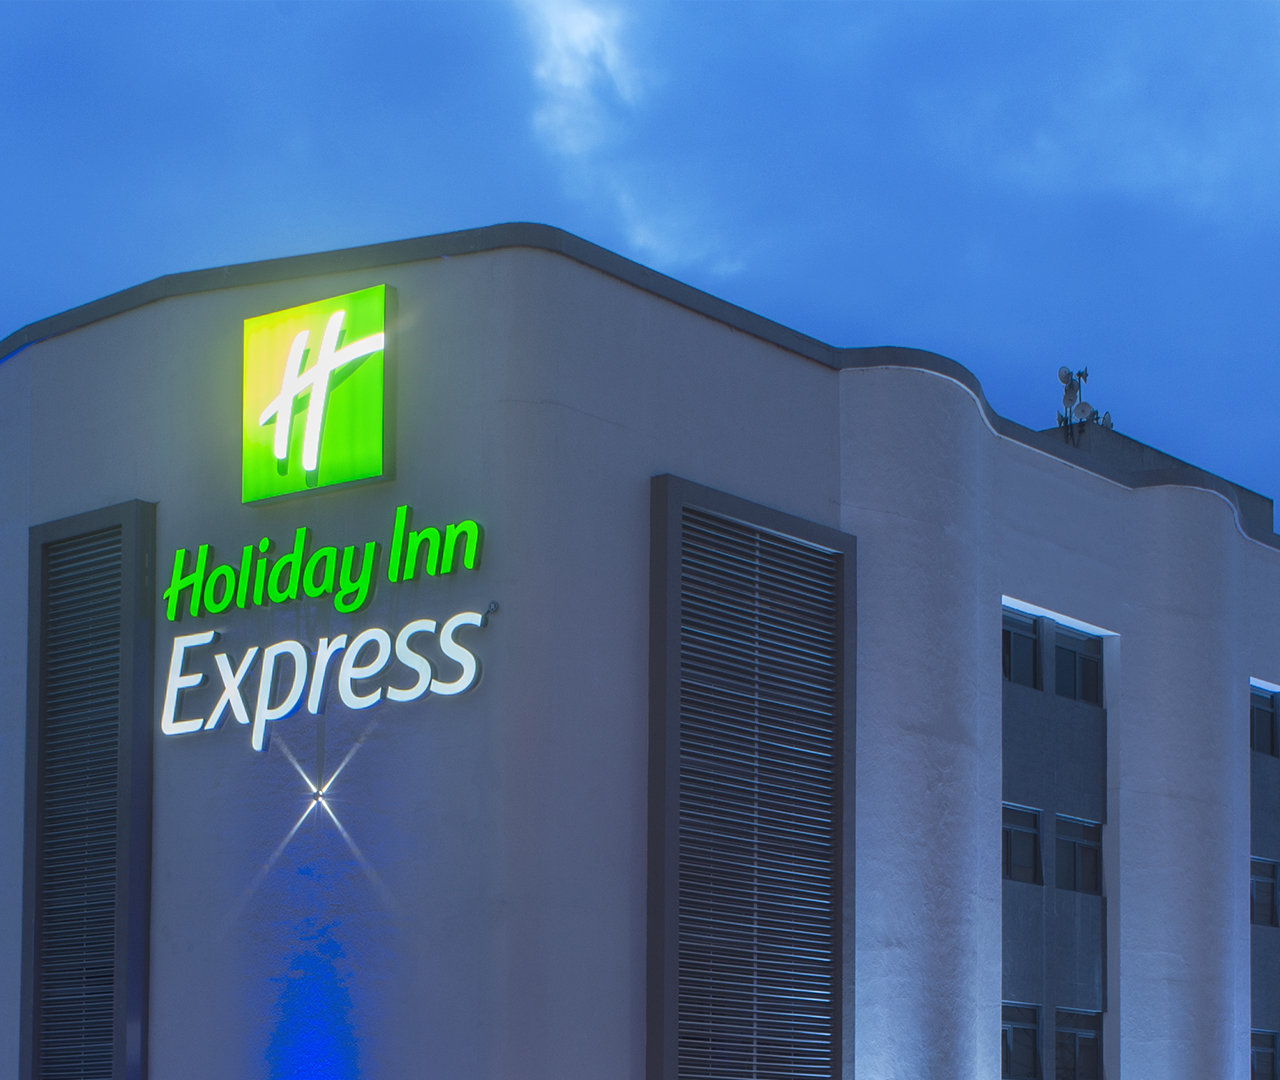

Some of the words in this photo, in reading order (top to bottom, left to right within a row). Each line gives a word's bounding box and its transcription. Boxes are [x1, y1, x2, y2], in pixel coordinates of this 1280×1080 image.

[163, 527, 377, 621] Holiday
[388, 504, 481, 583] Inn
[161, 612, 483, 752] Express
